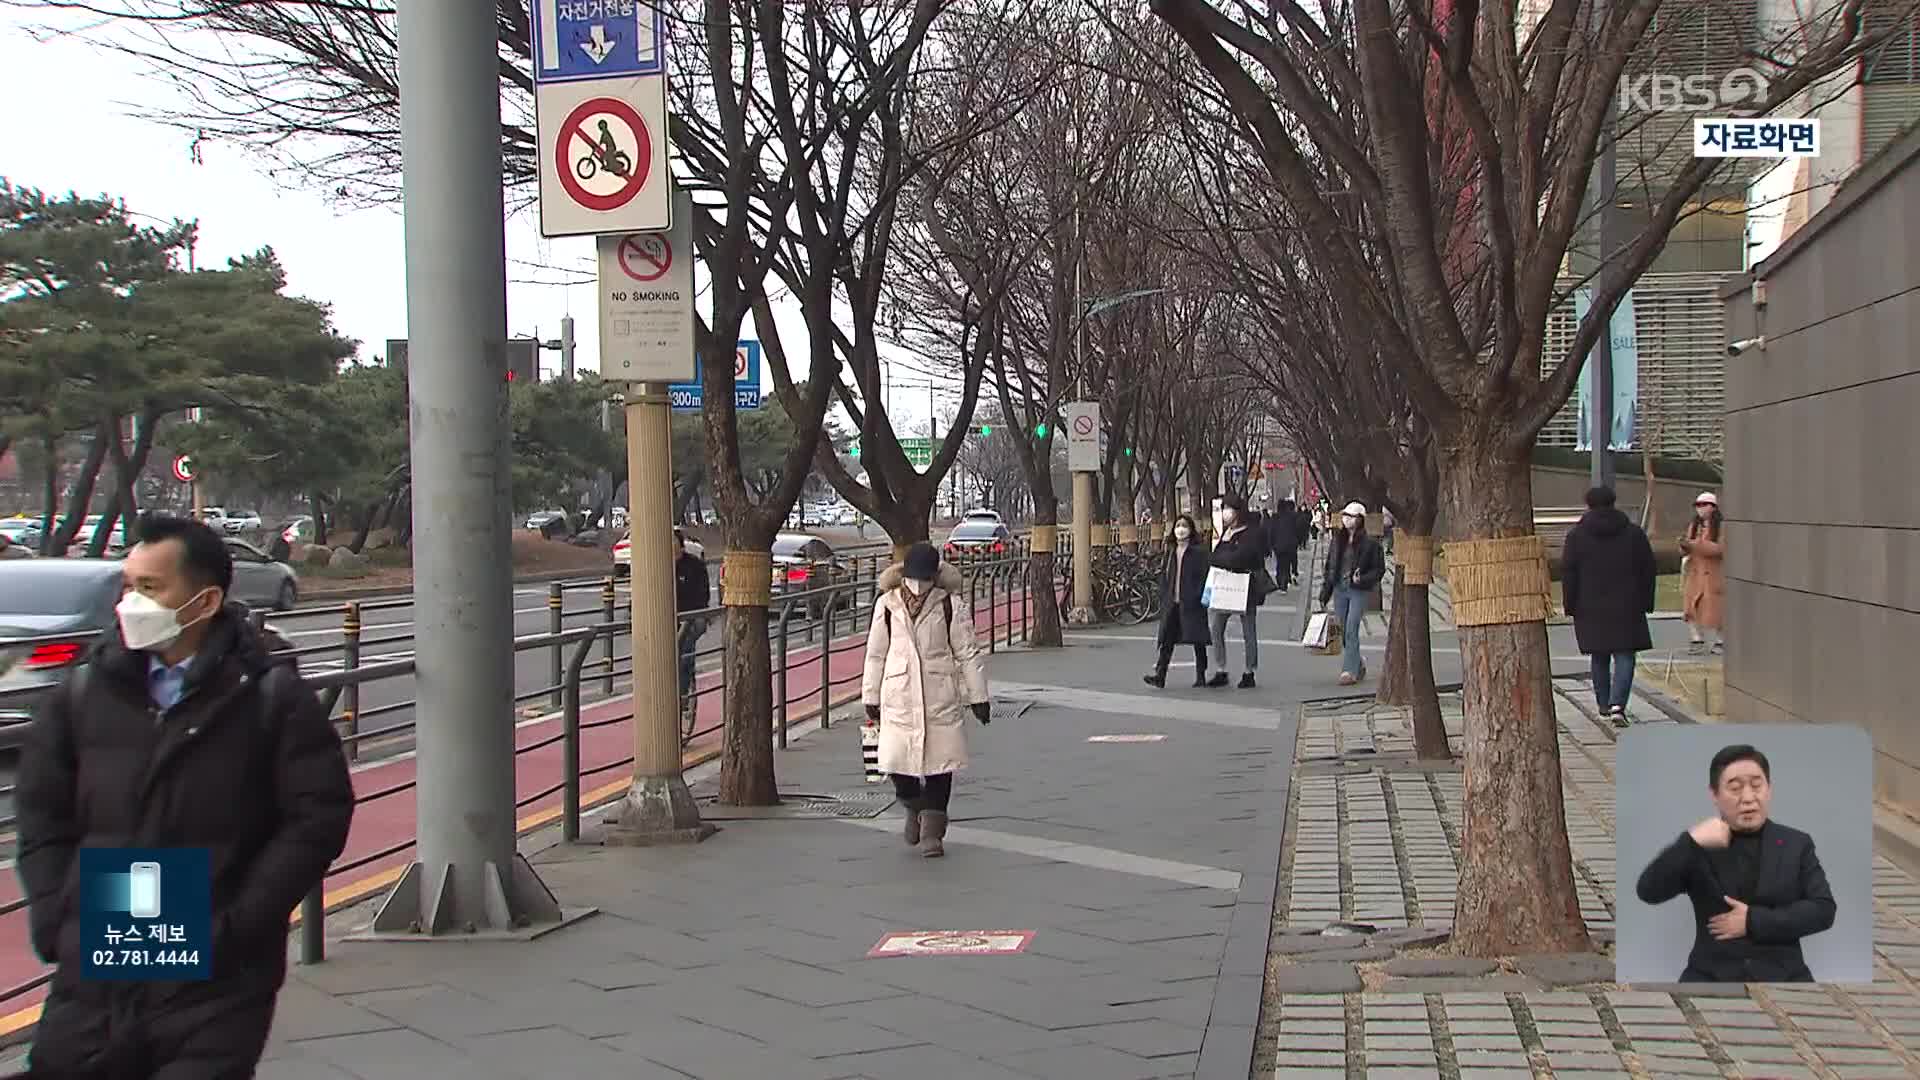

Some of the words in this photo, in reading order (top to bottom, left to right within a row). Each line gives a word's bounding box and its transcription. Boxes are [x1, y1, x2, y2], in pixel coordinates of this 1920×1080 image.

[559, 0, 634, 21] 자전거전용
[612, 291, 627, 302] NO
[632, 291, 680, 302] SMOKING
[735, 391, 757, 406] 구간
